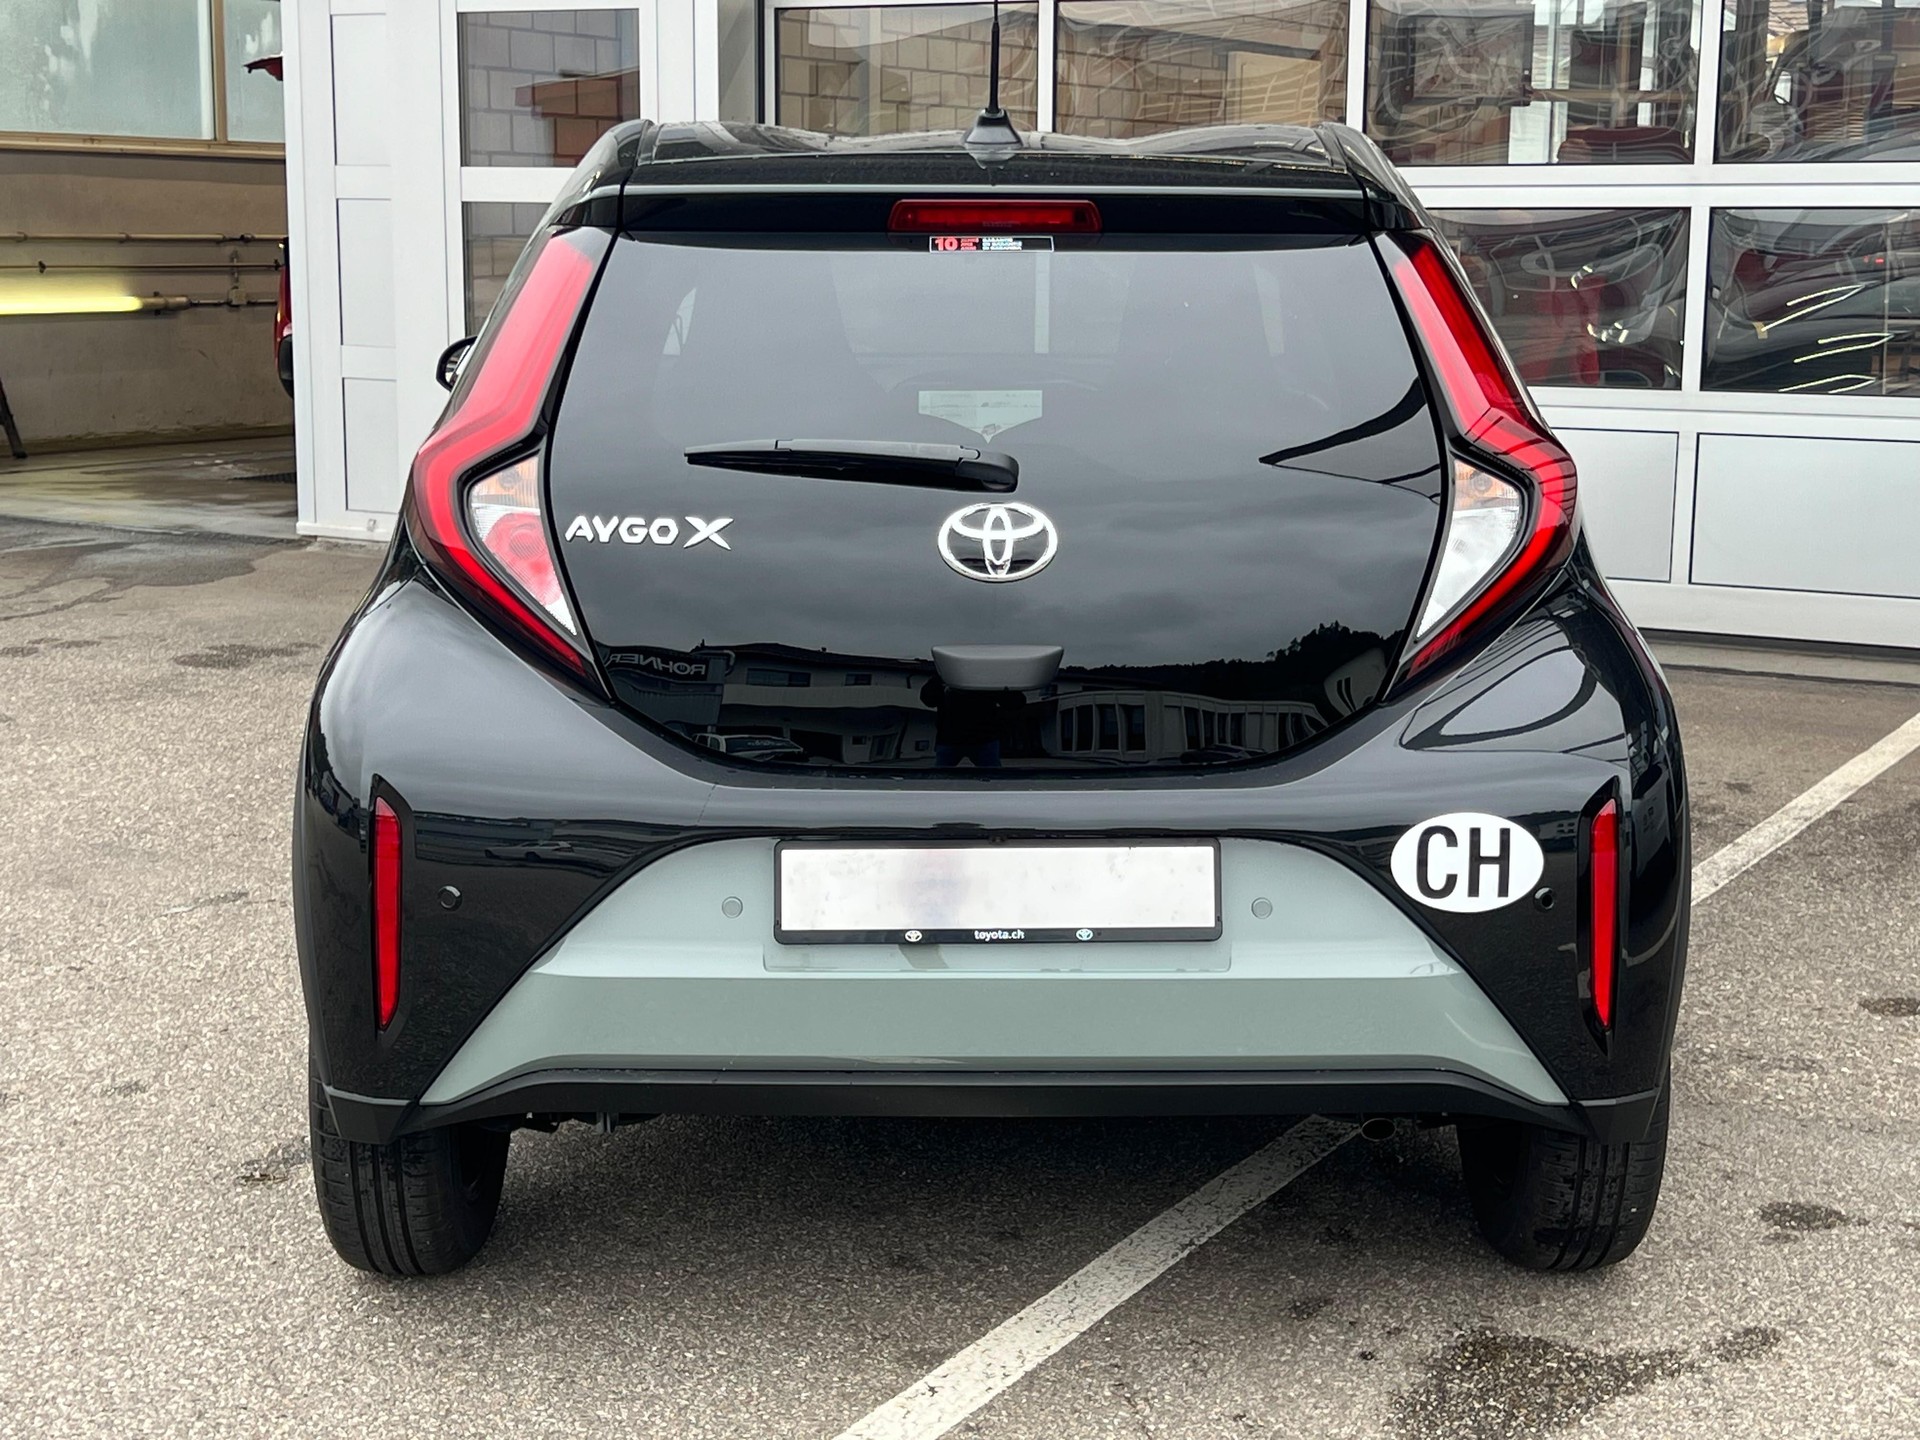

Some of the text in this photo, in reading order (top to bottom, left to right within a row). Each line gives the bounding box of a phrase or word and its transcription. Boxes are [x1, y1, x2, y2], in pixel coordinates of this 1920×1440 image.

[935, 236, 958, 251] 10
[564, 515, 735, 551] AYGO X
[1416, 825, 1511, 899] CH
[974, 929, 1025, 942] toyota.ch
